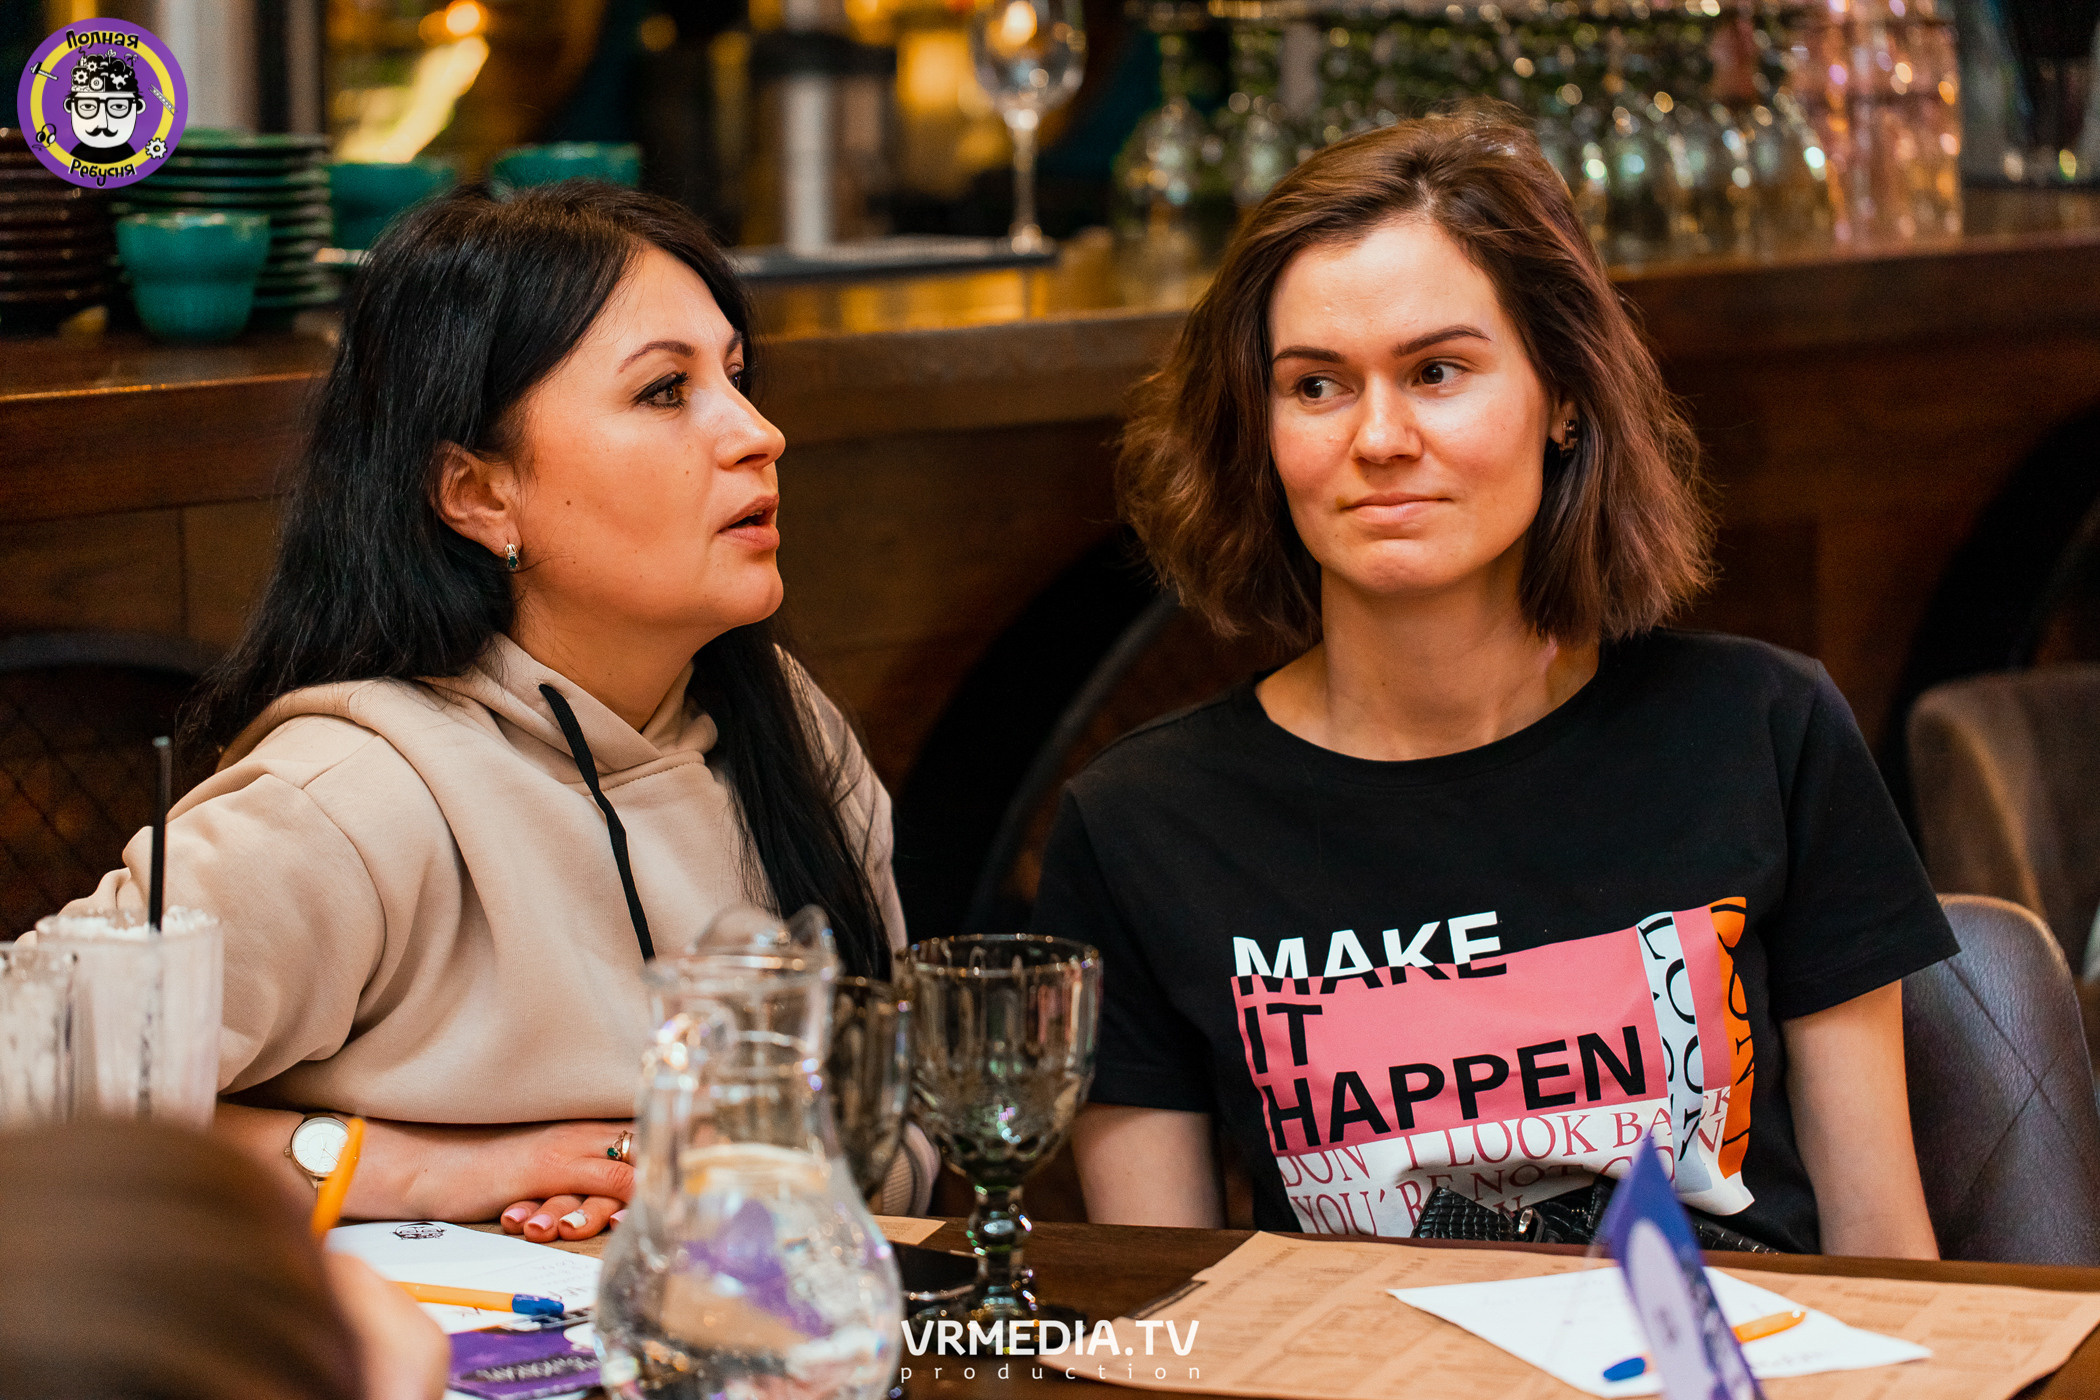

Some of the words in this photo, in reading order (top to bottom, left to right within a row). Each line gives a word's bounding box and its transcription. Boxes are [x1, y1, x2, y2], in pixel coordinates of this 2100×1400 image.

[1232, 910, 1508, 997] MAKE
[1243, 1002, 1324, 1076] IT
[1261, 1025, 1647, 1151] HAPPEN
[1443, 1114, 1599, 1168] LOOK
